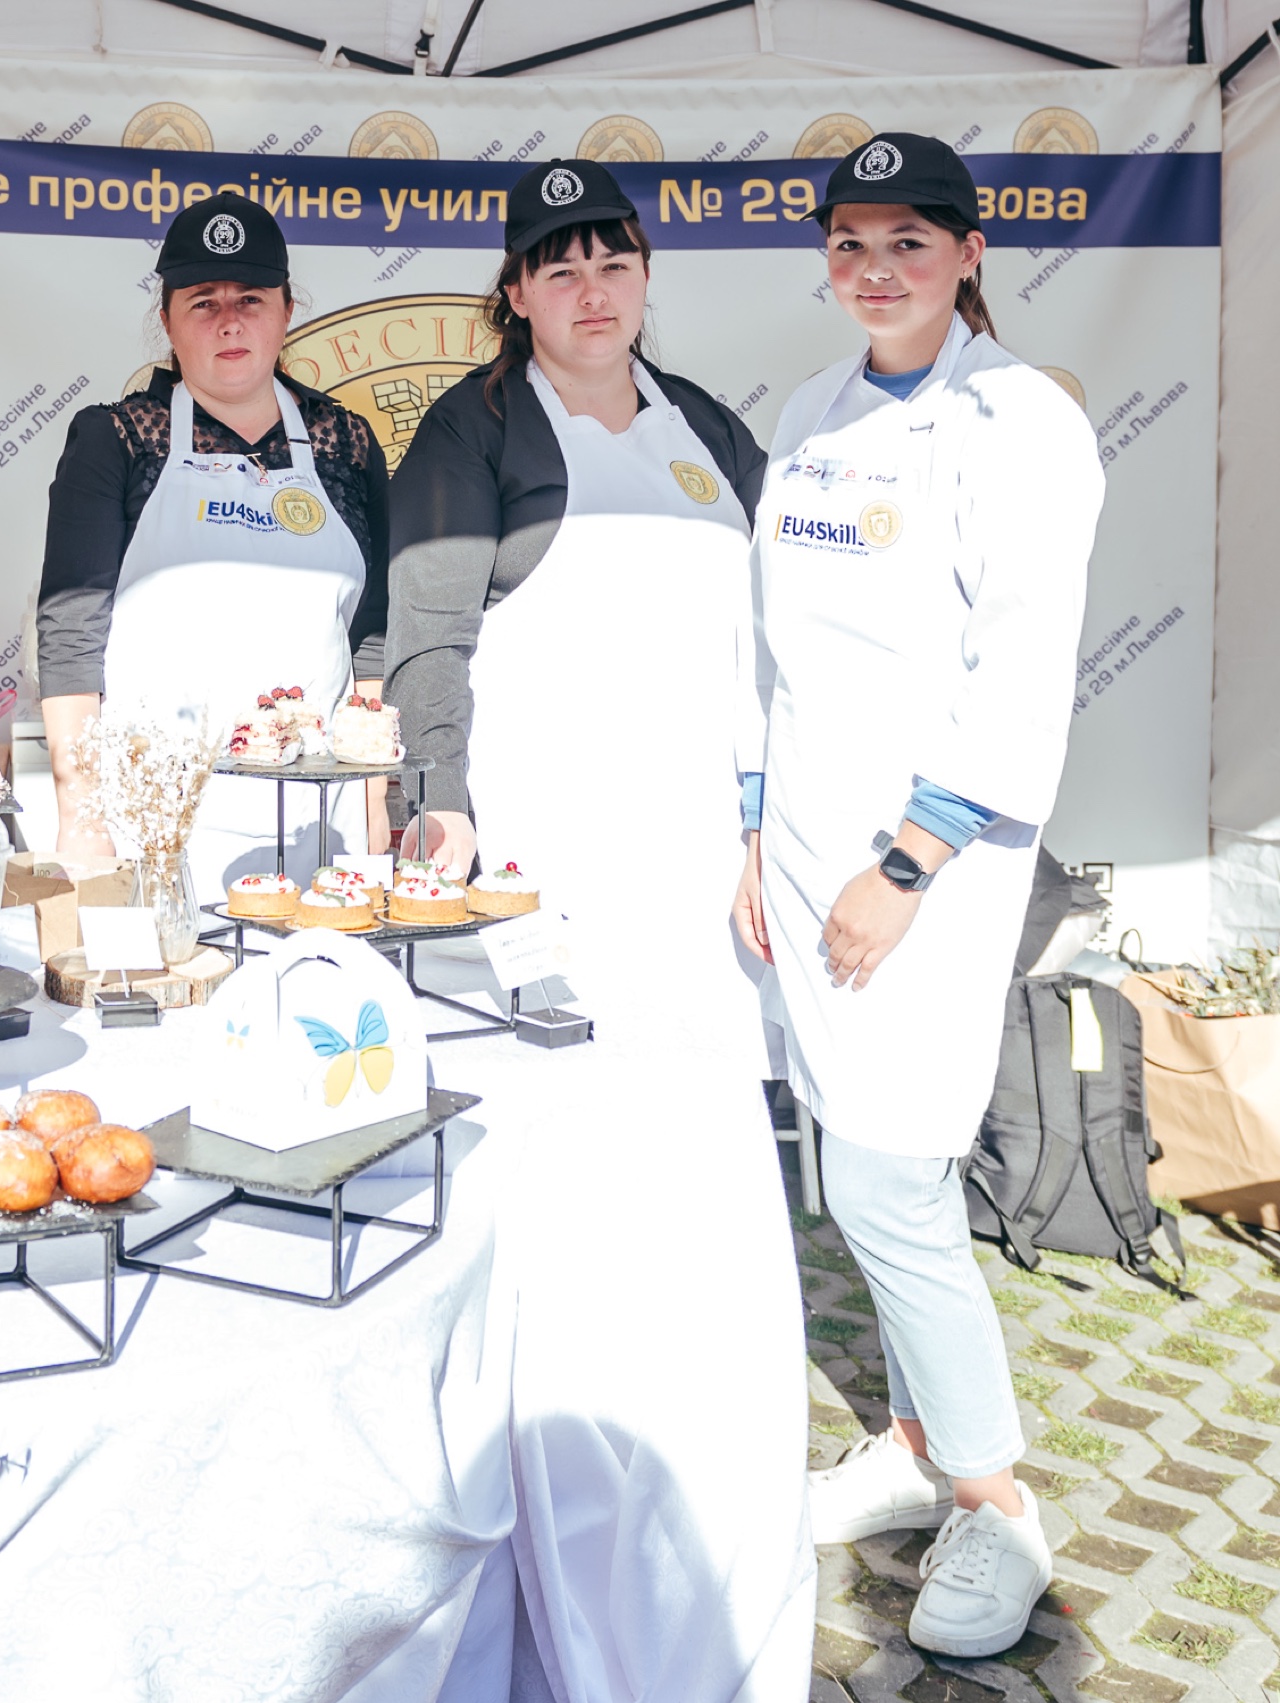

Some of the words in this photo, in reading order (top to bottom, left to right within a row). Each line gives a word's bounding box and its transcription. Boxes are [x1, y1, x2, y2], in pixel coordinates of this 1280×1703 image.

[660, 179, 723, 223] №
[741, 178, 818, 222] 29
[18, 374, 91, 446] м.Львова
[1097, 390, 1145, 440] есійне
[1117, 380, 1189, 449] м.Львова
[1088, 669, 1114, 696] 29
[1114, 605, 1185, 673] м.Львова
